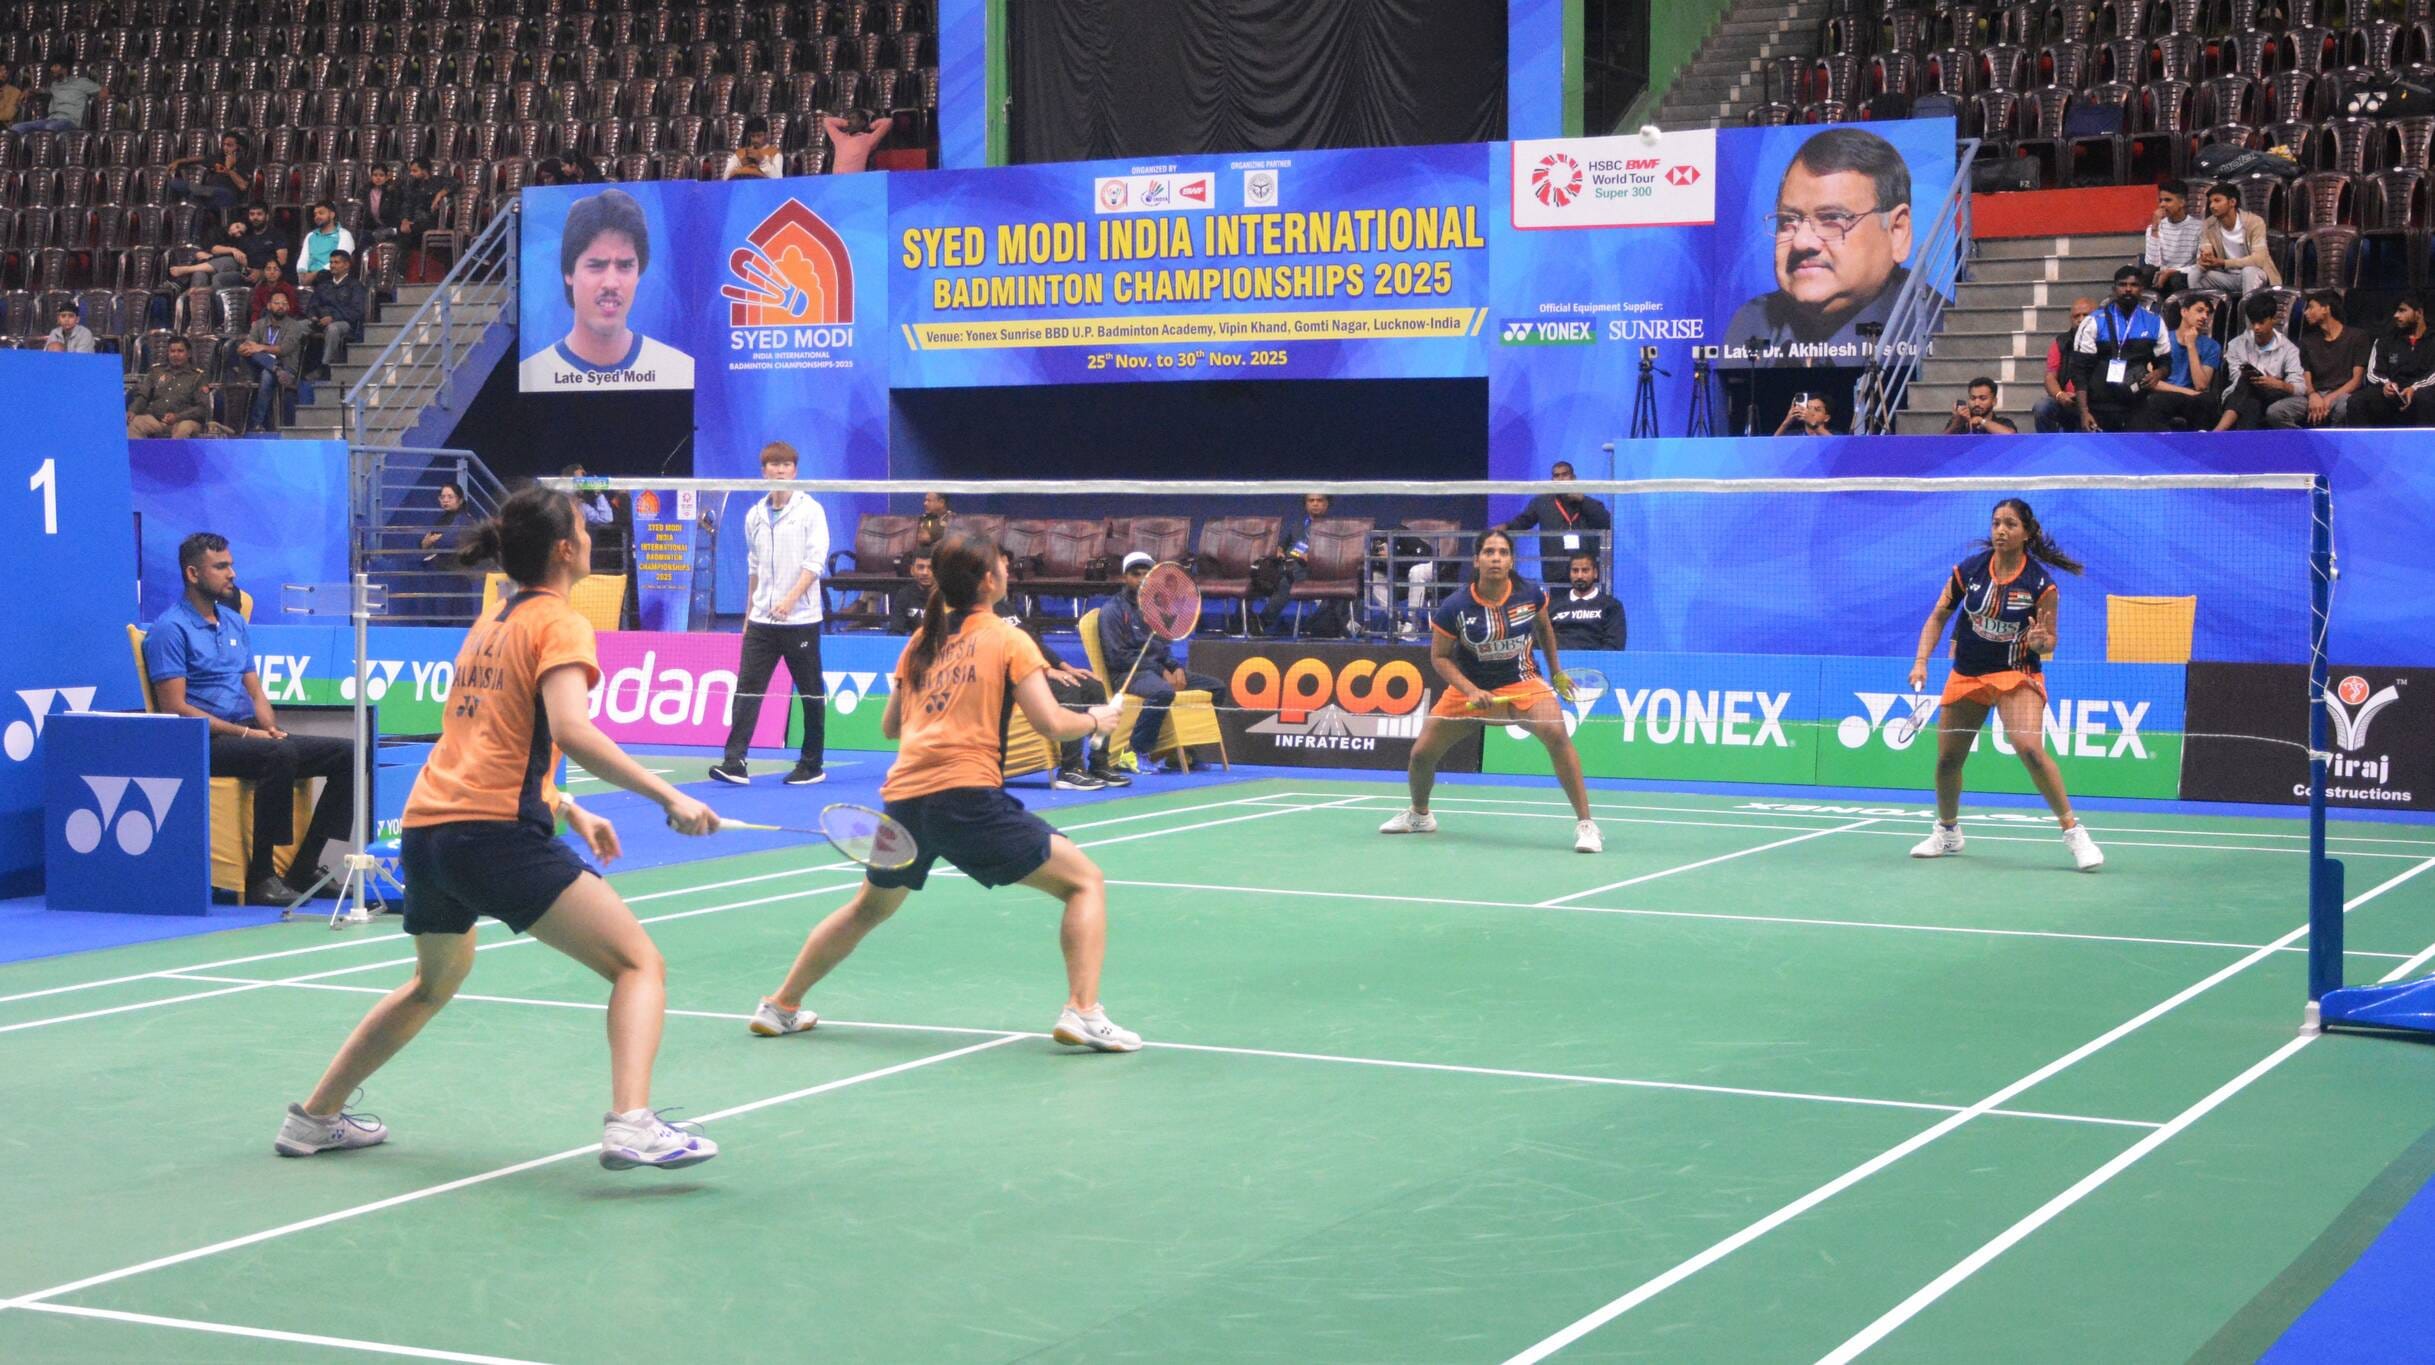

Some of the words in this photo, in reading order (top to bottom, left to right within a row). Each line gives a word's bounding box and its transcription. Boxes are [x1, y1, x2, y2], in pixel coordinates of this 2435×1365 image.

[1131, 165, 1167, 174] ORGANIZED
[1169, 165, 1177, 173] BY
[1266, 160, 1291, 168] PARTNER
[1589, 160, 1622, 171] HSBC
[1625, 159, 1661, 170] BWF
[1592, 174, 1627, 185] World
[1630, 173, 1655, 183] Tour
[1595, 187, 1628, 200] Super
[1632, 186, 1652, 197] 300
[903, 227, 985, 269] SYED
[997, 222, 1086, 265] MODI
[1099, 217, 1193, 261] INDIA
[1205, 205, 1485, 256] INTERNATIONAL
[933, 273, 1103, 309] BADMINTON
[1114, 263, 1365, 303] CHAMPIONSHIPS
[1374, 262, 1452, 295] 2025
[1539, 303, 1571, 313] Official
[1573, 303, 1621, 314] Equipment
[1623, 302, 1663, 313] Supplier:
[927, 331, 963, 343] Venue:
[966, 330, 997, 341] Yonex
[1000, 328, 1042, 340] Sunrise
[1045, 327, 1069, 339] BBD
[1073, 326, 1094, 338] U.P.
[1098, 325, 1159, 337] Badminton
[1161, 323, 1216, 336] Academy,
[1219, 322, 1247, 336] Vipin
[1251, 320, 1291, 334] Khand,
[1294, 320, 1329, 332] Gomti
[1332, 319, 1370, 333] Nagar,
[1374, 317, 1461, 331] Lucknow-India
[1537, 322, 1591, 340] YONEX
[1609, 319, 1704, 340] SUNRISE
[731, 330, 788, 350] SYED
[794, 328, 853, 348] MODI
[775, 351, 830, 359] INTERNATIONAL
[1788, 342, 1856, 357] Akhilesh
[1862, 342, 1891, 356] Ds
[729, 362, 774, 370] BADMINTON
[1115, 353, 1152, 368] Nov.
[1157, 354, 1173, 367] to
[1209, 352, 1246, 366] Nov.
[1250, 350, 1288, 365] 2025
[554, 372, 583, 384] Late
[587, 370, 619, 386] Syed
[624, 370, 656, 382] Modi
[30, 459, 57, 534] 1
[1571, 609, 1602, 619] YONEX
[1985, 618, 2017, 633] DBS
[1231, 657, 1423, 723] apco
[1615, 688, 1791, 747] YONEX
[1275, 734, 1375, 750] INFRATECH
[2293, 784, 2412, 801] Costructions
[1734, 802, 1934, 818] YONEX
